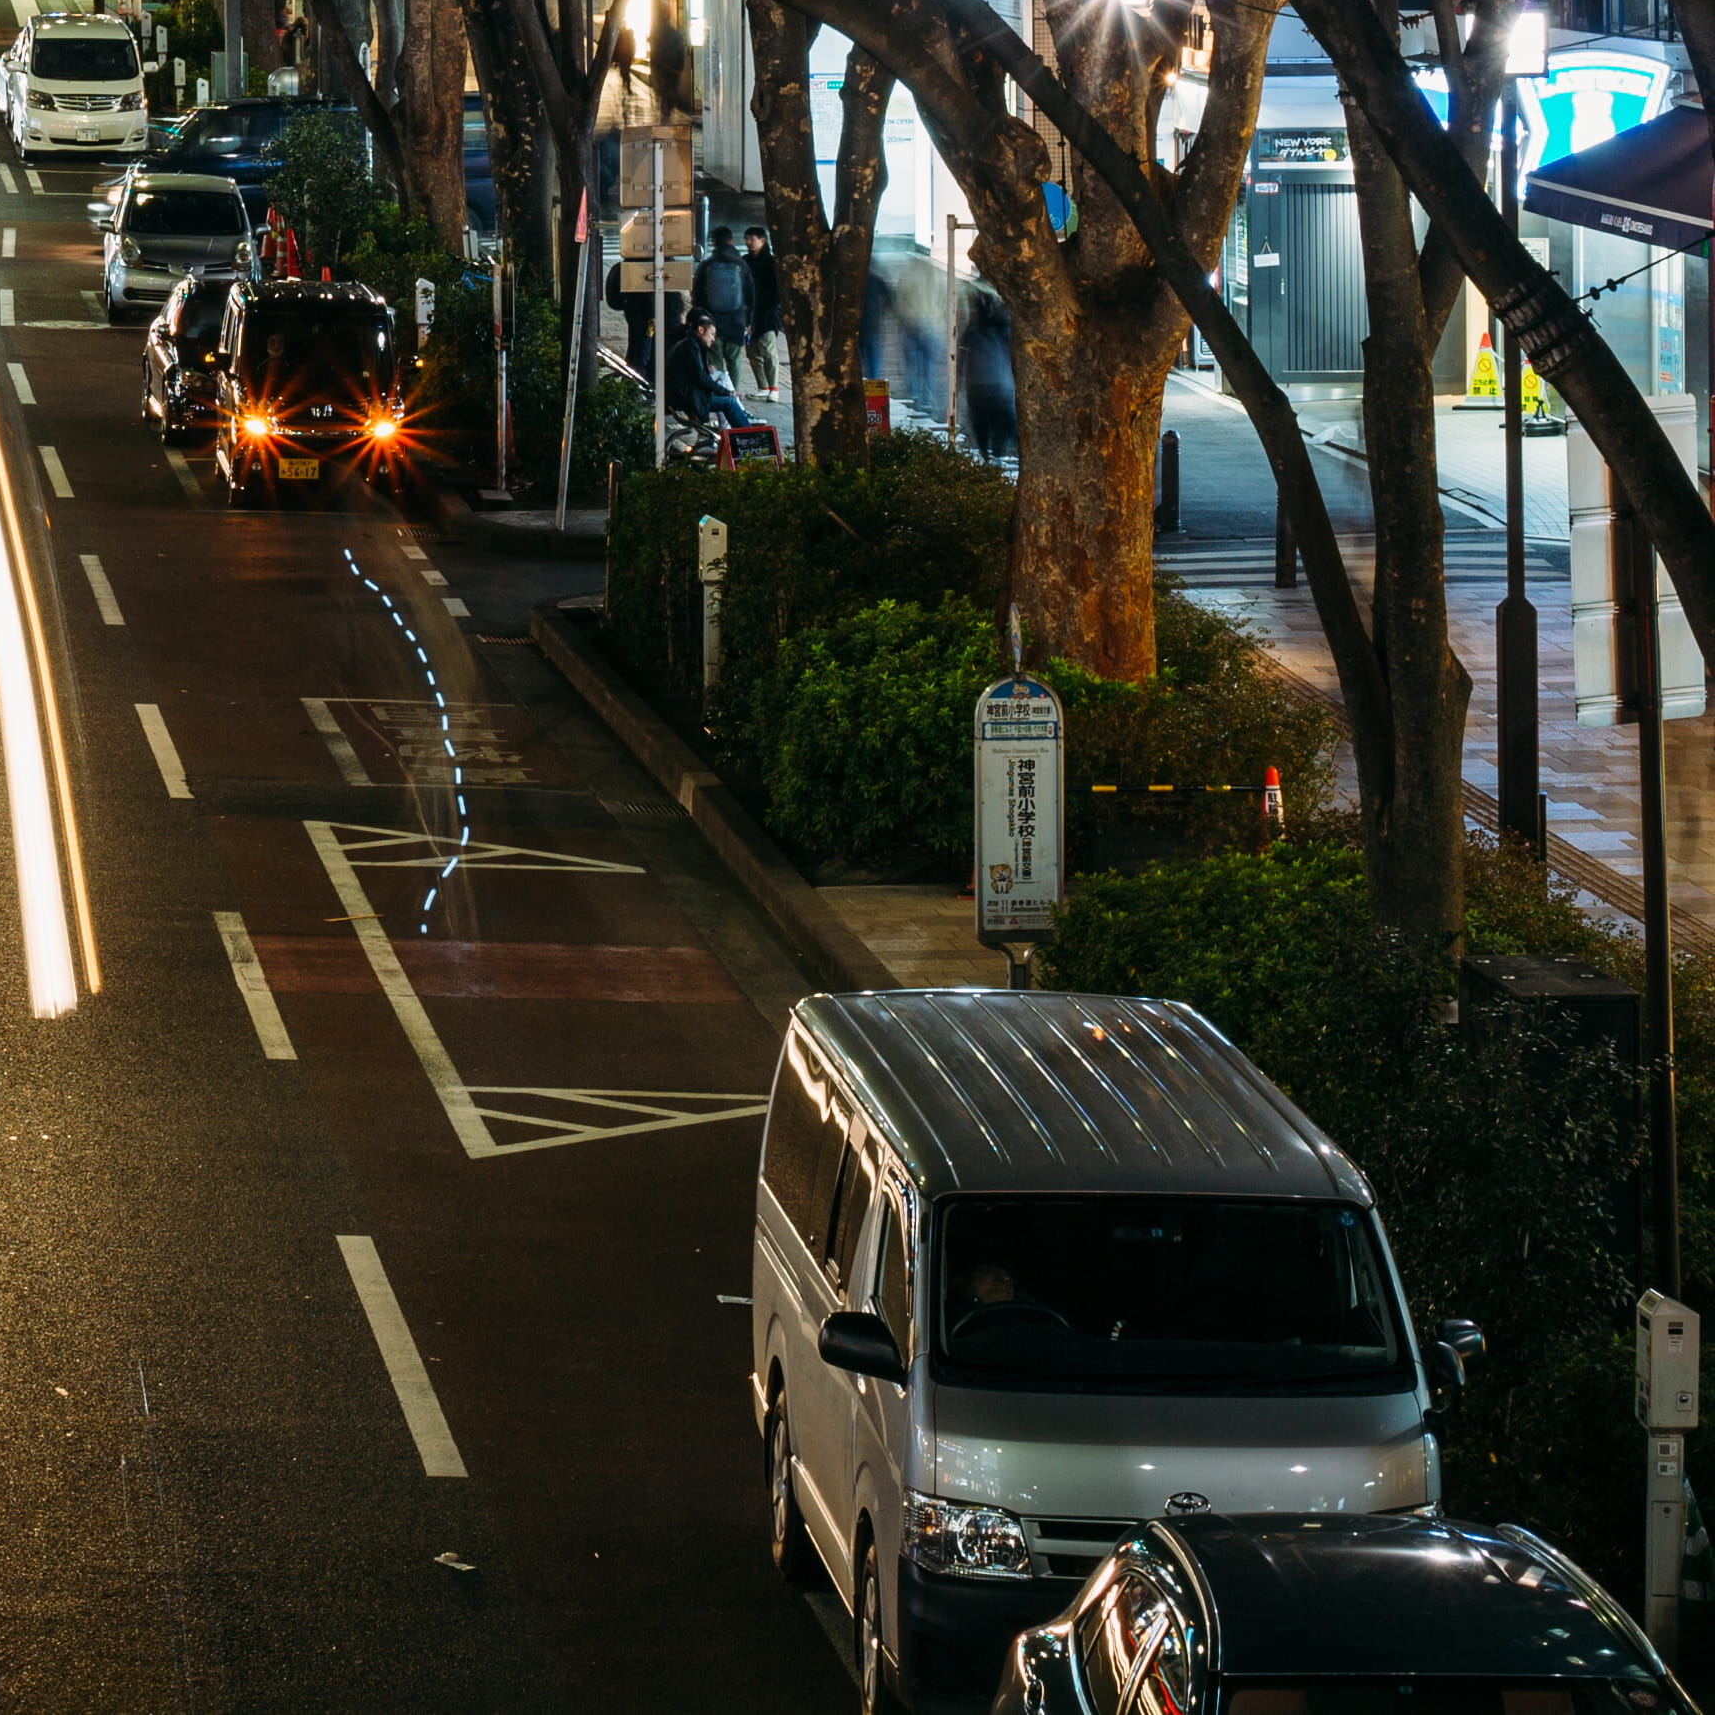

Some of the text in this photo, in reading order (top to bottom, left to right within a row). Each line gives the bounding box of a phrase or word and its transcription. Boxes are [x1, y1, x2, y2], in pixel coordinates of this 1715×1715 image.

[1275, 136, 1332, 147] NEW YORK
[1007, 758, 1016, 838] Jingumae Shogakko
[1017, 758, 1036, 838] 神宮前小学校
